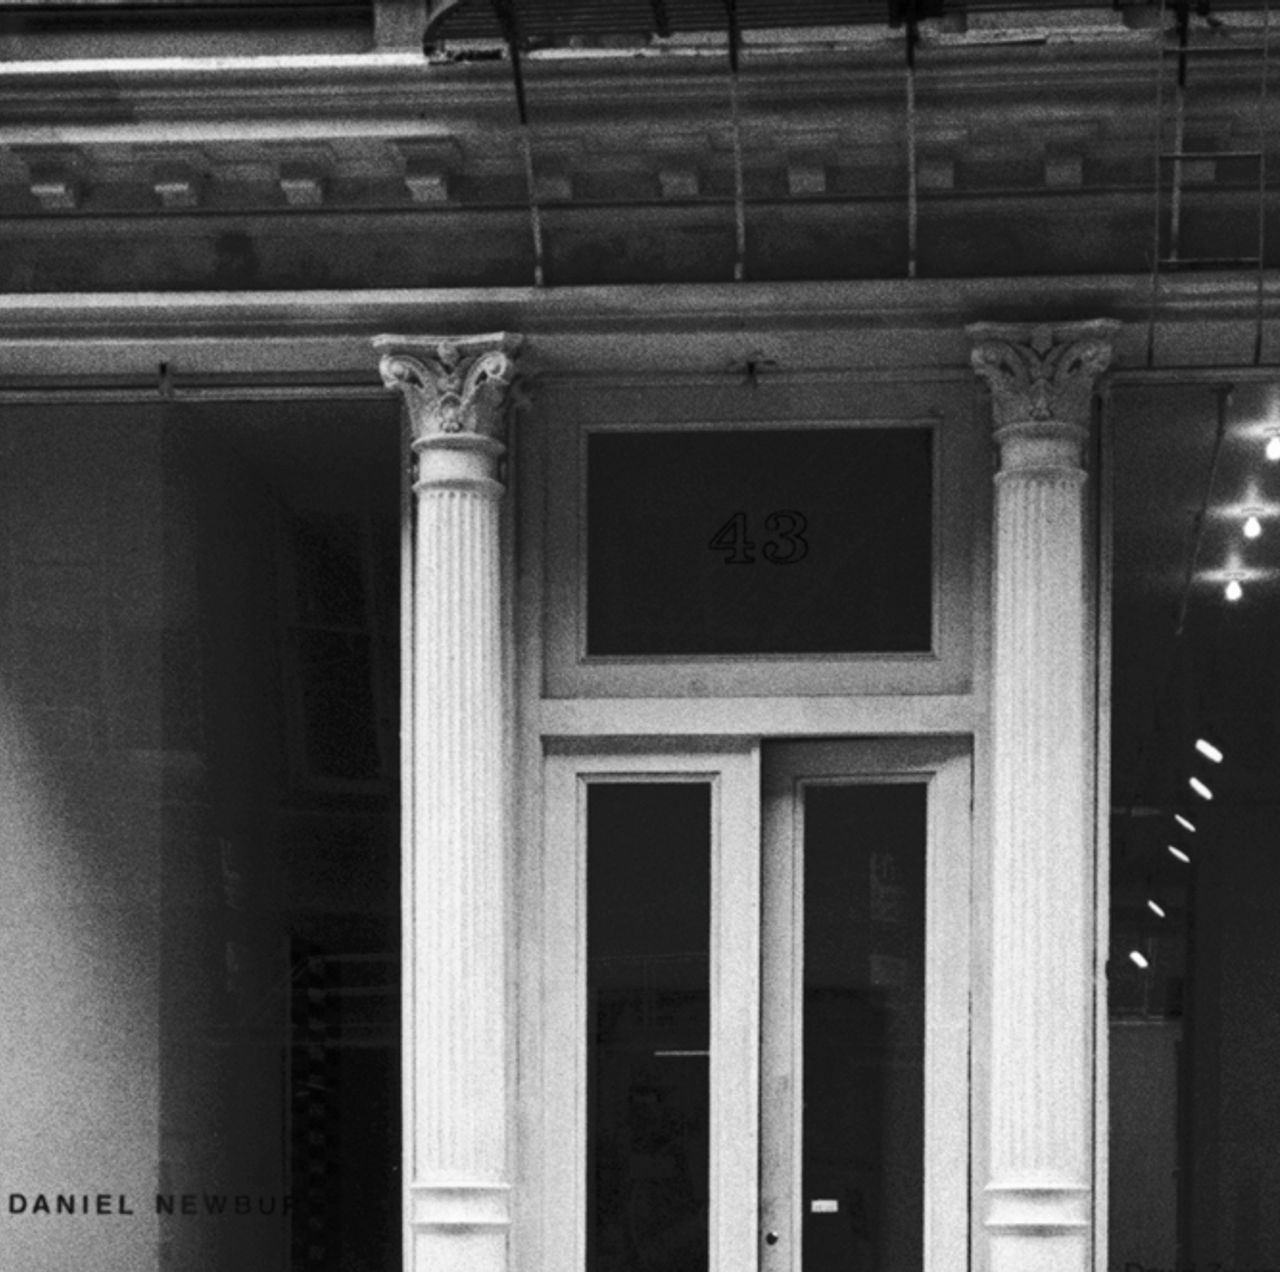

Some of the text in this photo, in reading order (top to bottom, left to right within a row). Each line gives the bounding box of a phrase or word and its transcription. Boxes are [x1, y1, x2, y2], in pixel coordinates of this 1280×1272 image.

[709, 509, 809, 565] 43
[8, 1193, 301, 1216] DANIEL NEWBUR
